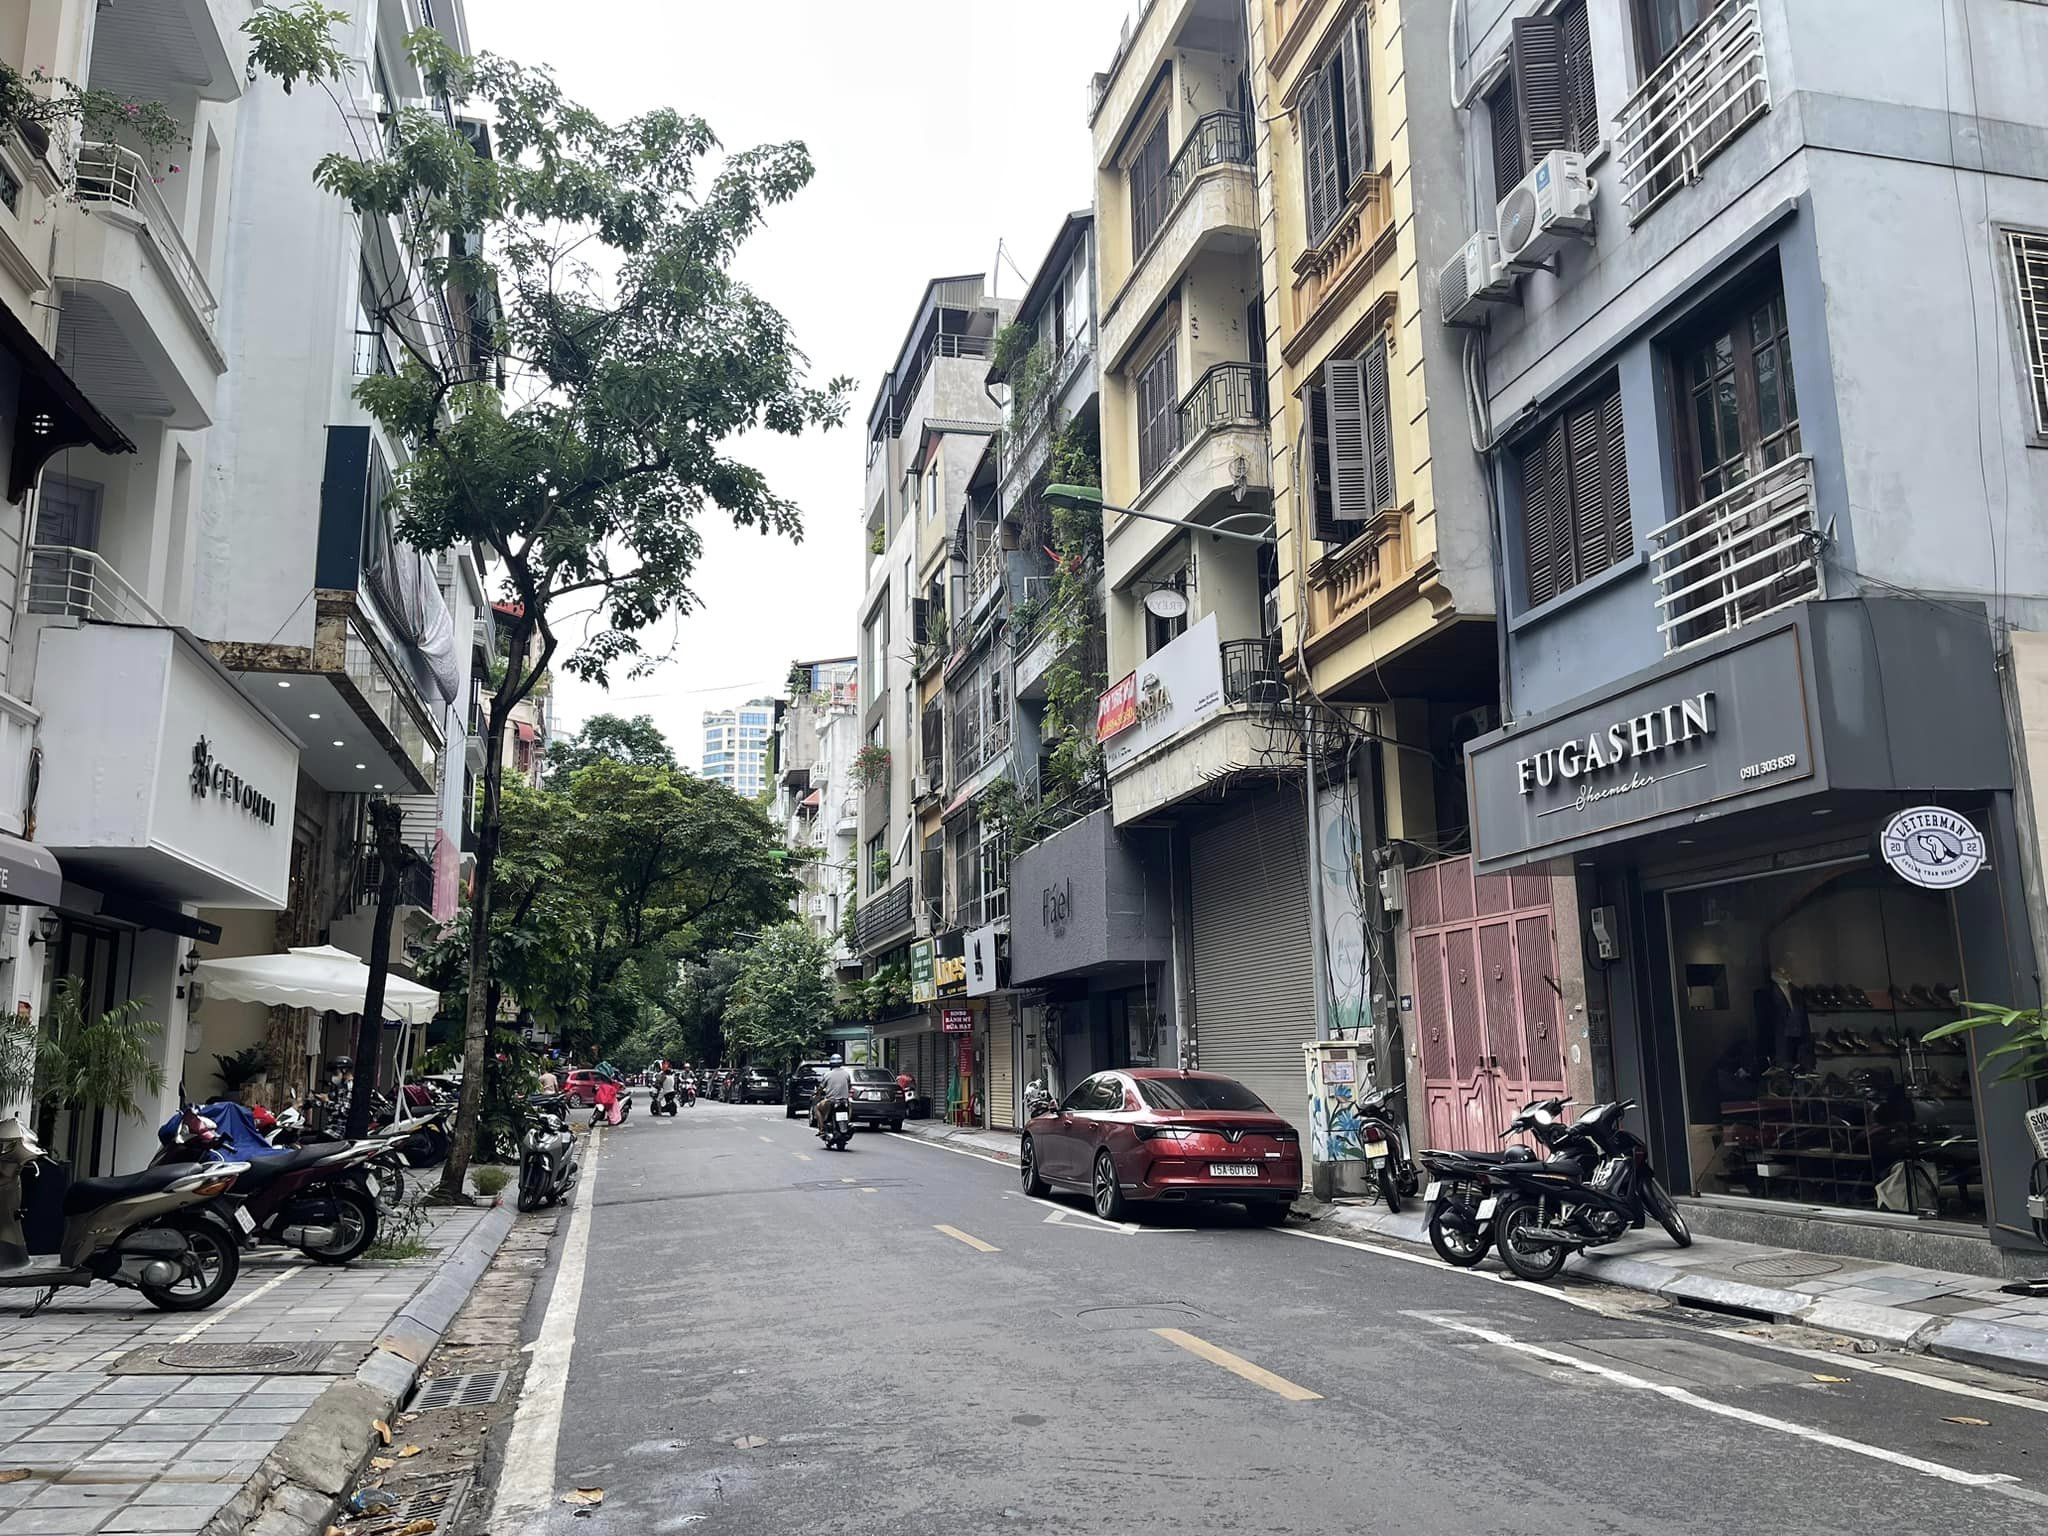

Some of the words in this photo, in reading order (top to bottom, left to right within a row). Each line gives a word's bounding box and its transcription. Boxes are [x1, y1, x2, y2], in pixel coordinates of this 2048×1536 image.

[1516, 691, 1717, 794] FUGASHIN
[1740, 764, 1760, 779] 0911
[1760, 759, 1777, 774] 303
[1575, 771, 1655, 812] Shoemaker
[1896, 815, 1966, 838] LETTERMAN
[1890, 842, 1901, 852] 20
[1966, 842, 1978, 852] 22
